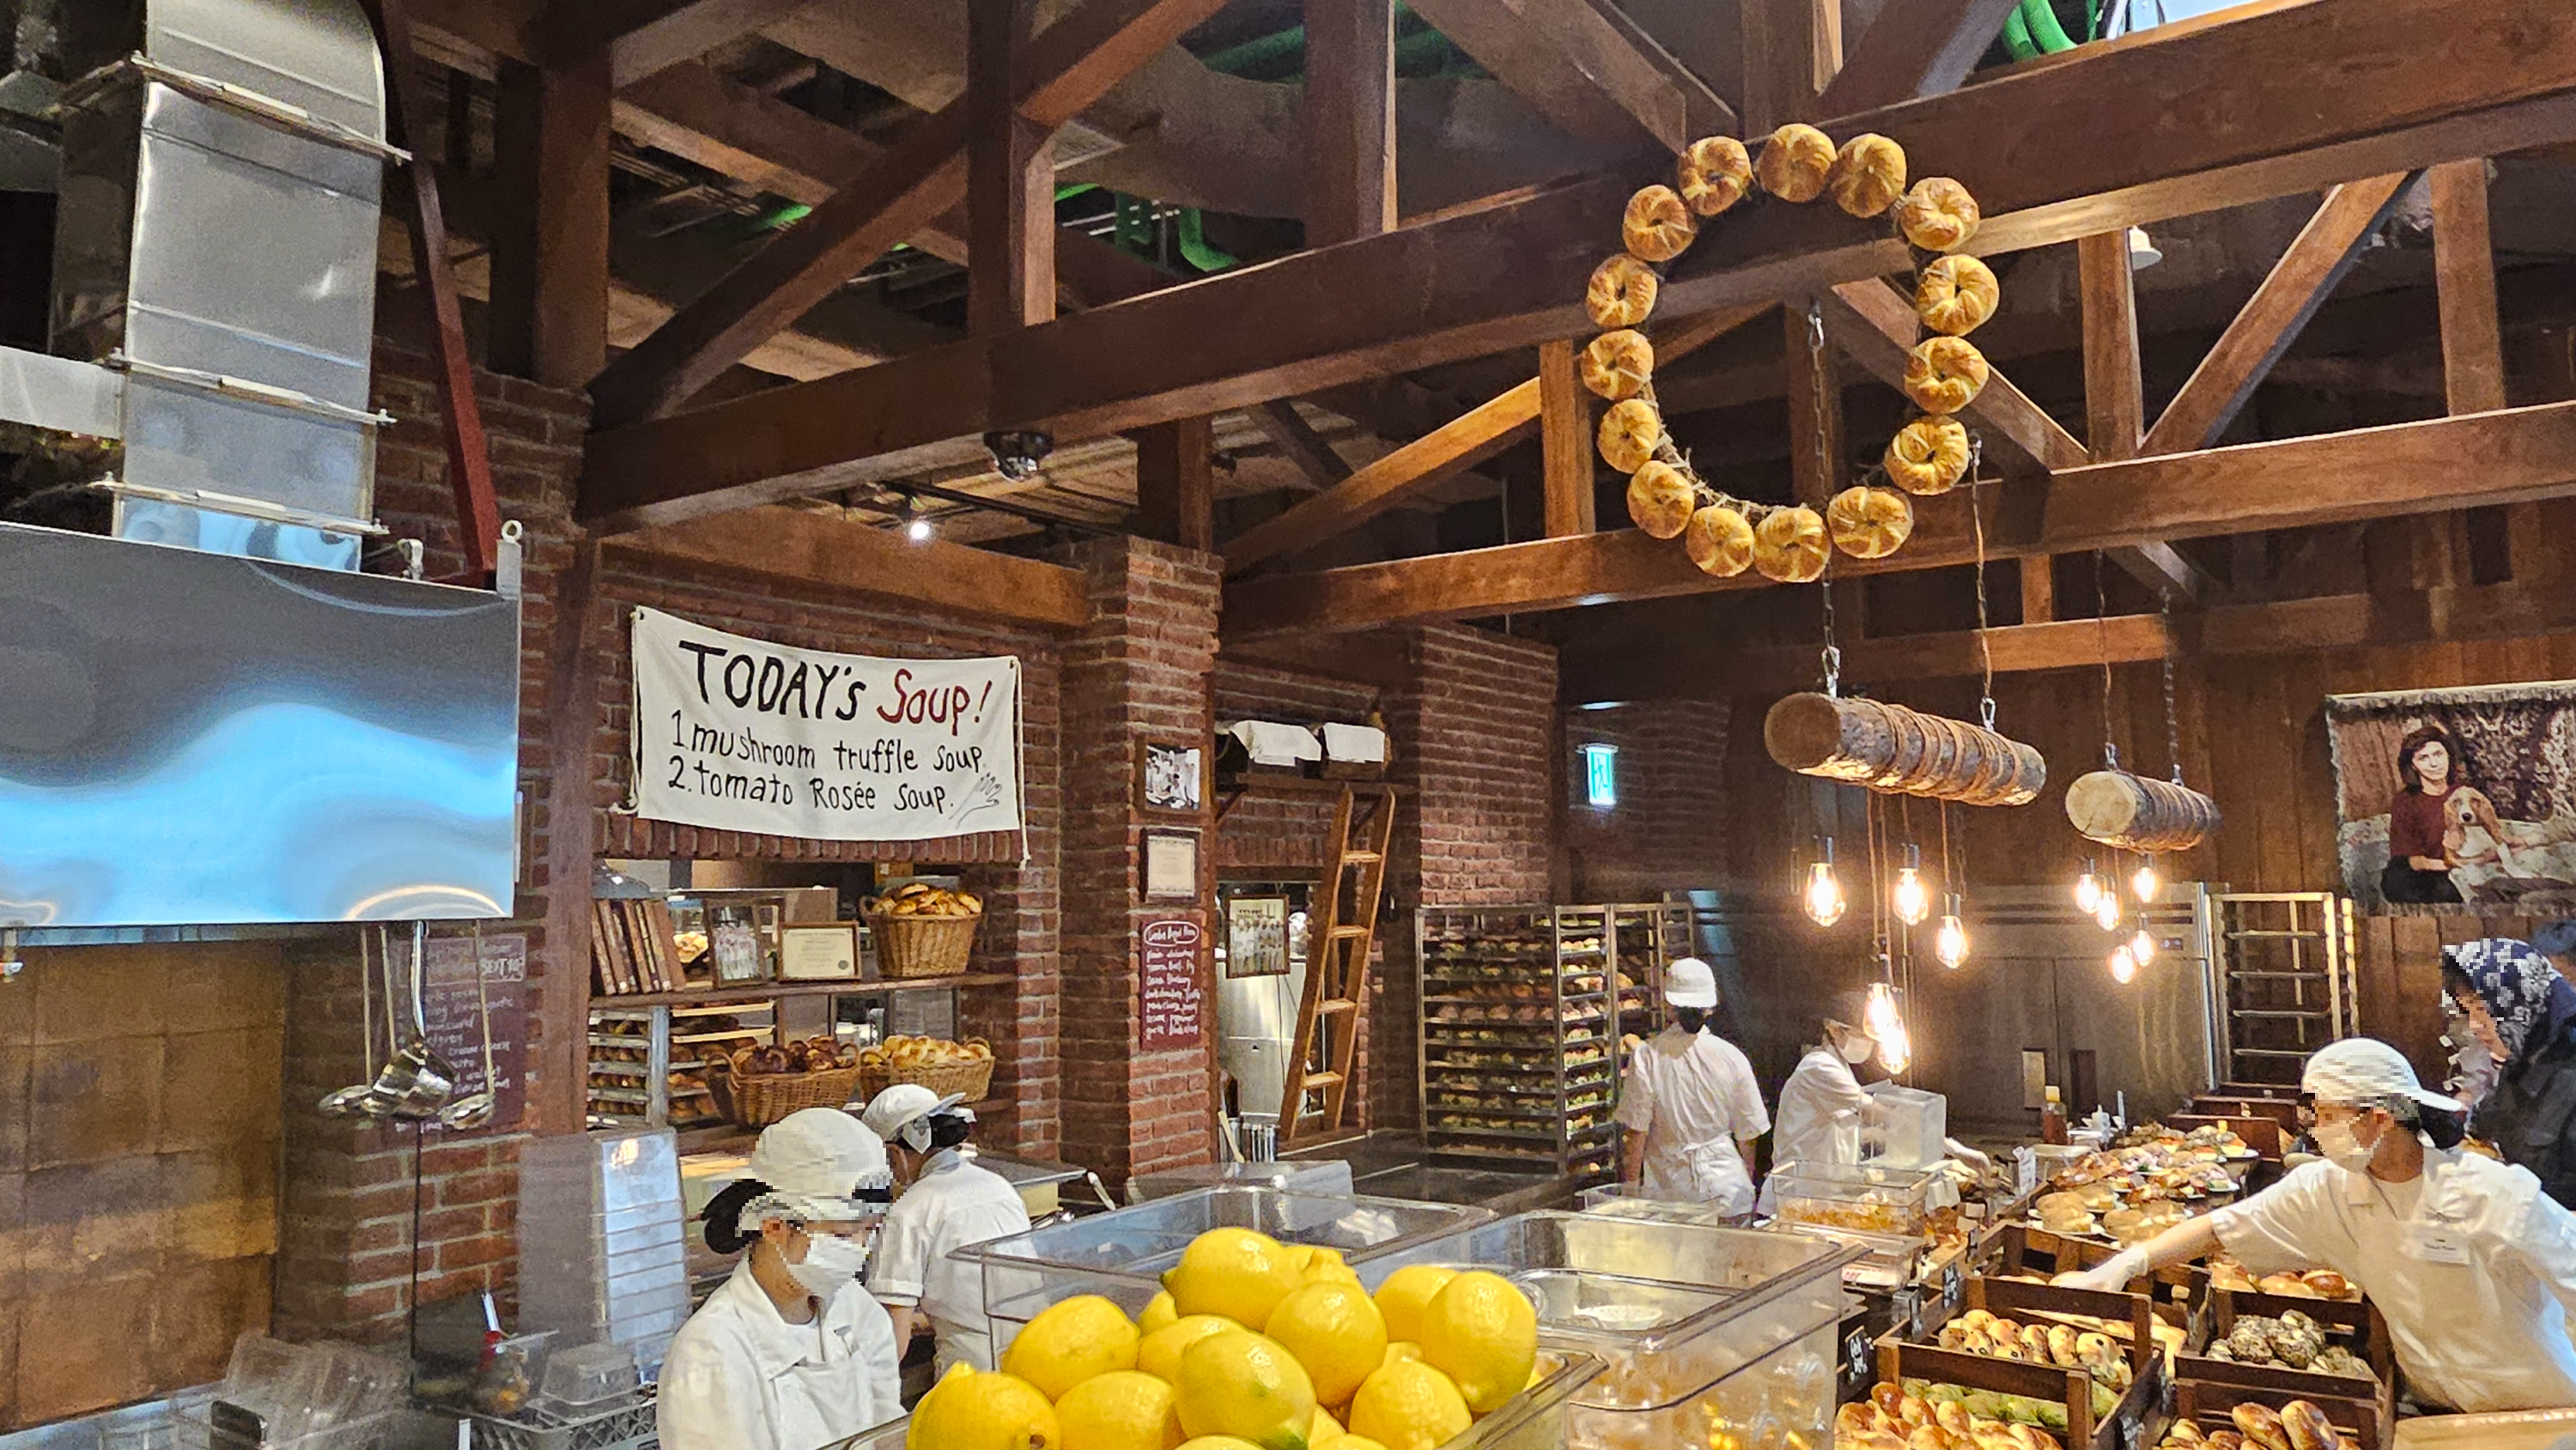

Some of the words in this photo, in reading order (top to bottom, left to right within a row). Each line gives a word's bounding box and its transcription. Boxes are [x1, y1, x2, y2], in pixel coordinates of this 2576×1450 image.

[677, 640, 867, 721] TODAY's
[876, 668, 993, 737] Soup!
[832, 738, 919, 774] truffle
[808, 777, 876, 811] Rosée
